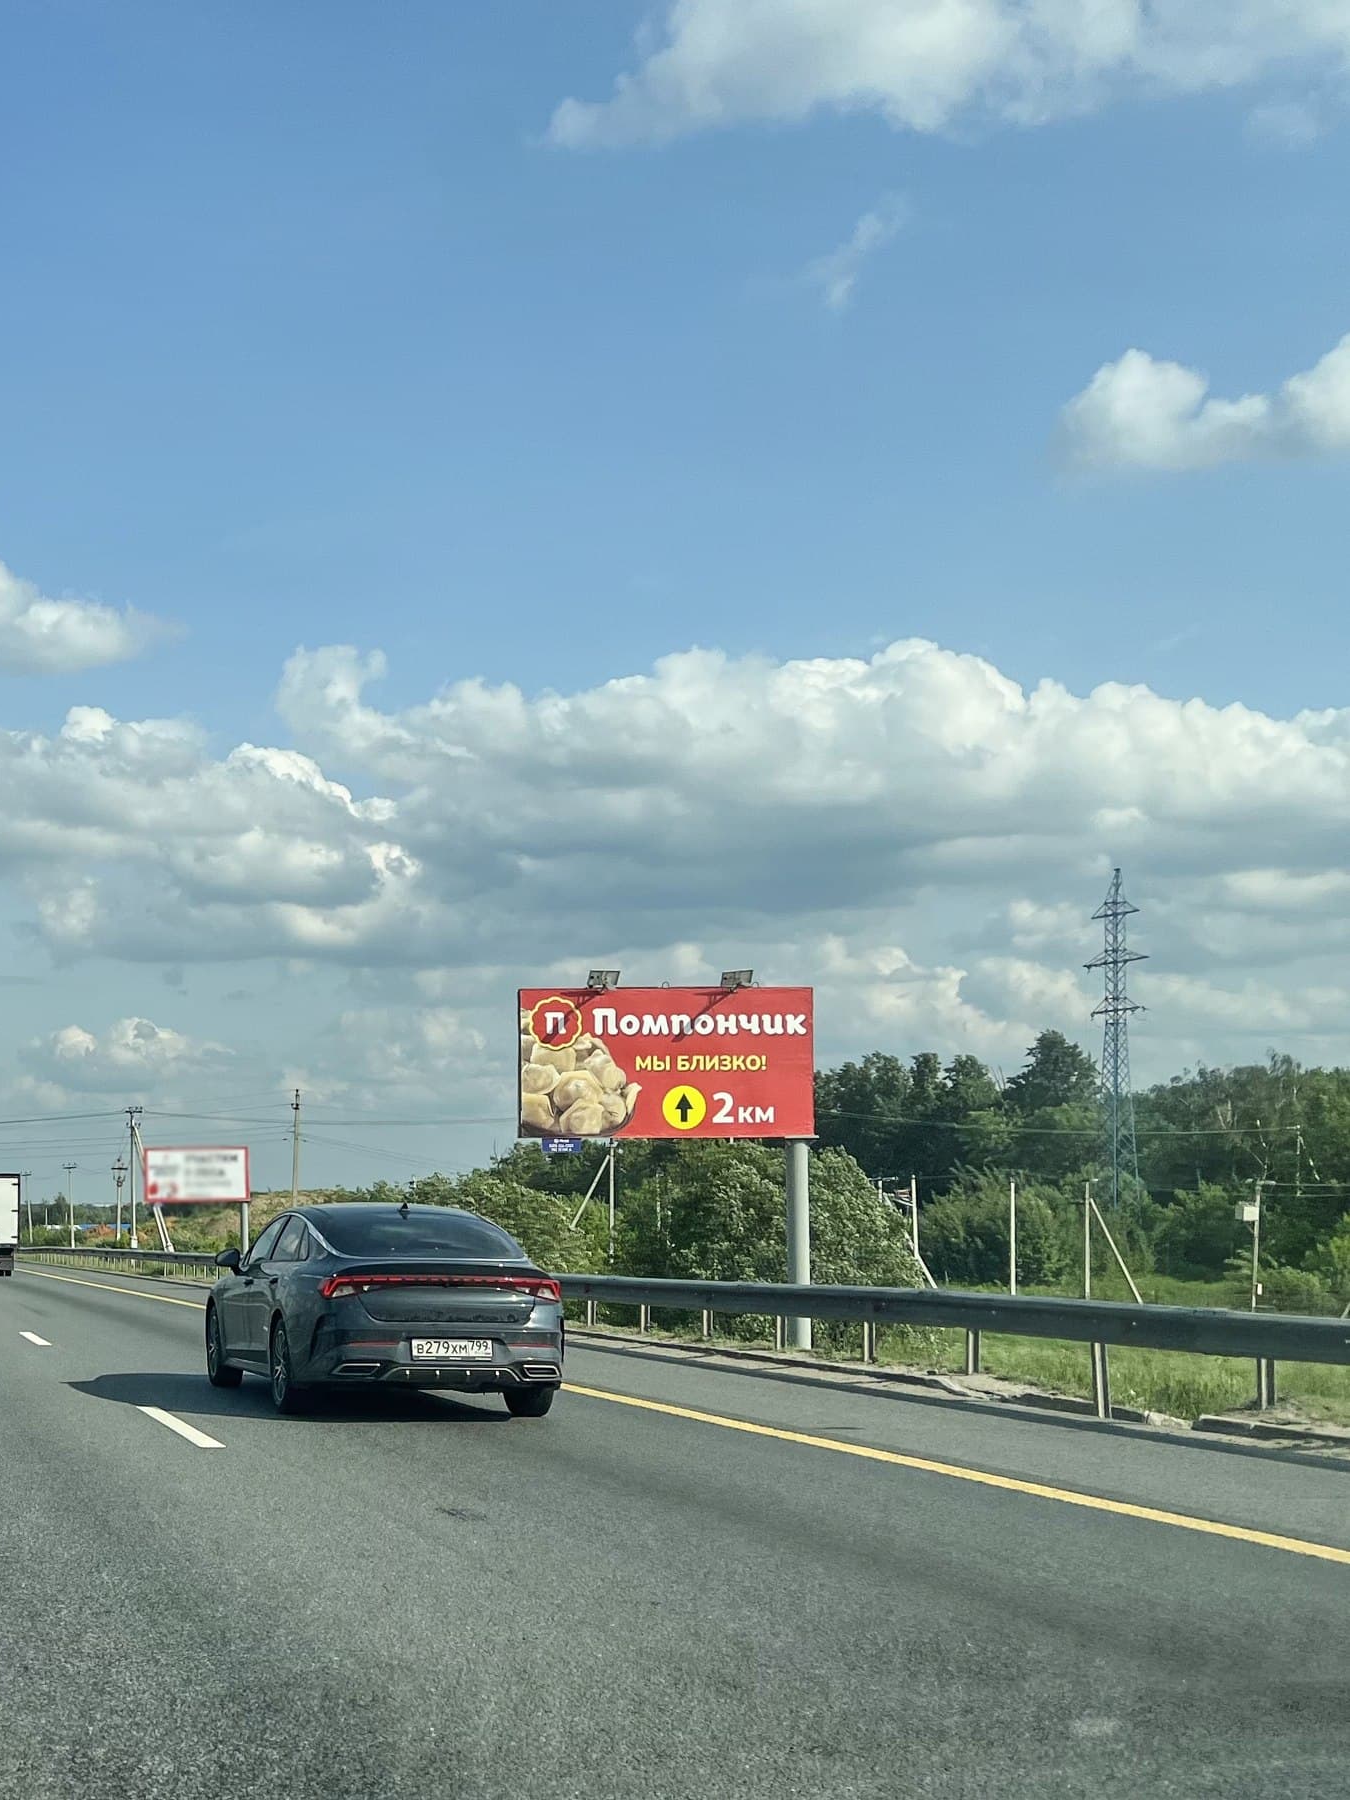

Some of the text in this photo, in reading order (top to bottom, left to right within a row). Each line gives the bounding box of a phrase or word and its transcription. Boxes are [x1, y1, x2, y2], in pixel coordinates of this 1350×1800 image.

[544, 1011, 566, 1035] П
[592, 1007, 807, 1036] Помпончик
[635, 1055, 767, 1071] МЫ БЛИЗКО!
[712, 1091, 734, 1123] 2
